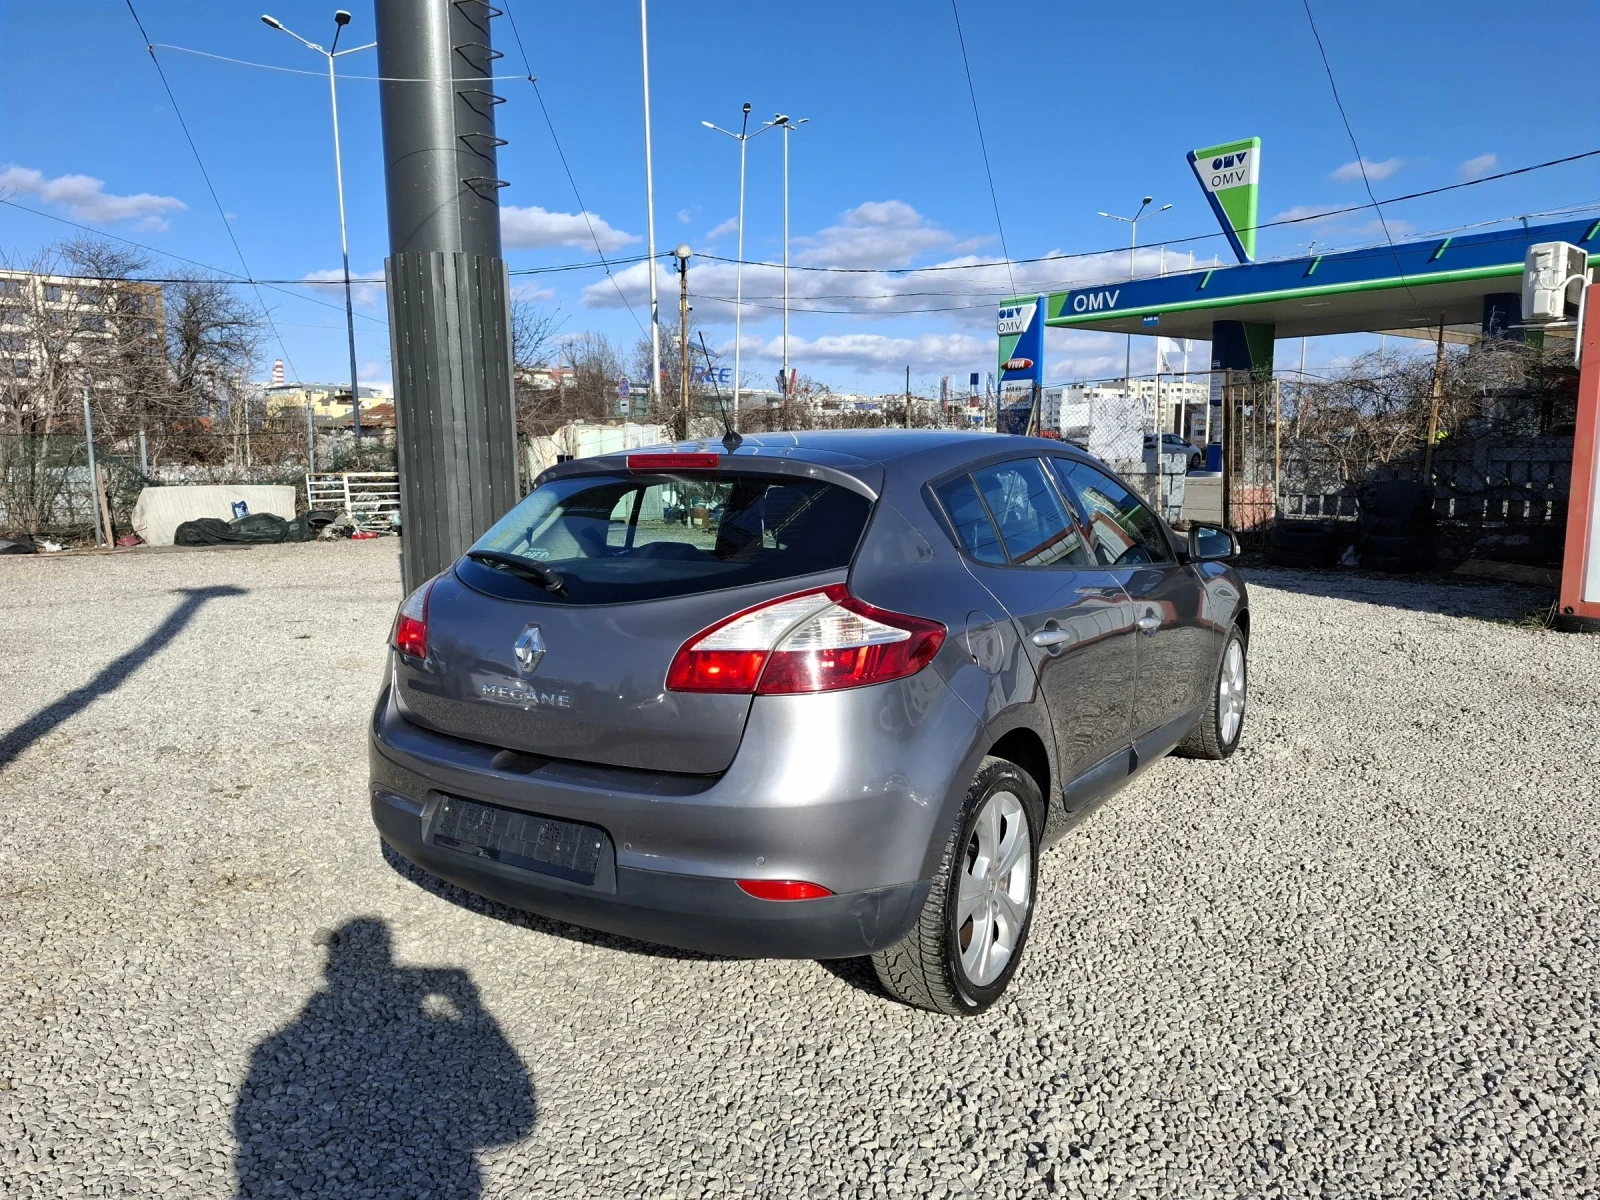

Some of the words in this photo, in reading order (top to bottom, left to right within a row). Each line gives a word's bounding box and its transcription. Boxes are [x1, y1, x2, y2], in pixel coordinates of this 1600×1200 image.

[1211, 169, 1246, 187] OMV
[1073, 289, 1121, 312] OMV
[998, 321, 1022, 332] OMV
[1007, 359, 1025, 369] VIVA
[482, 683, 570, 709] MEGANE
